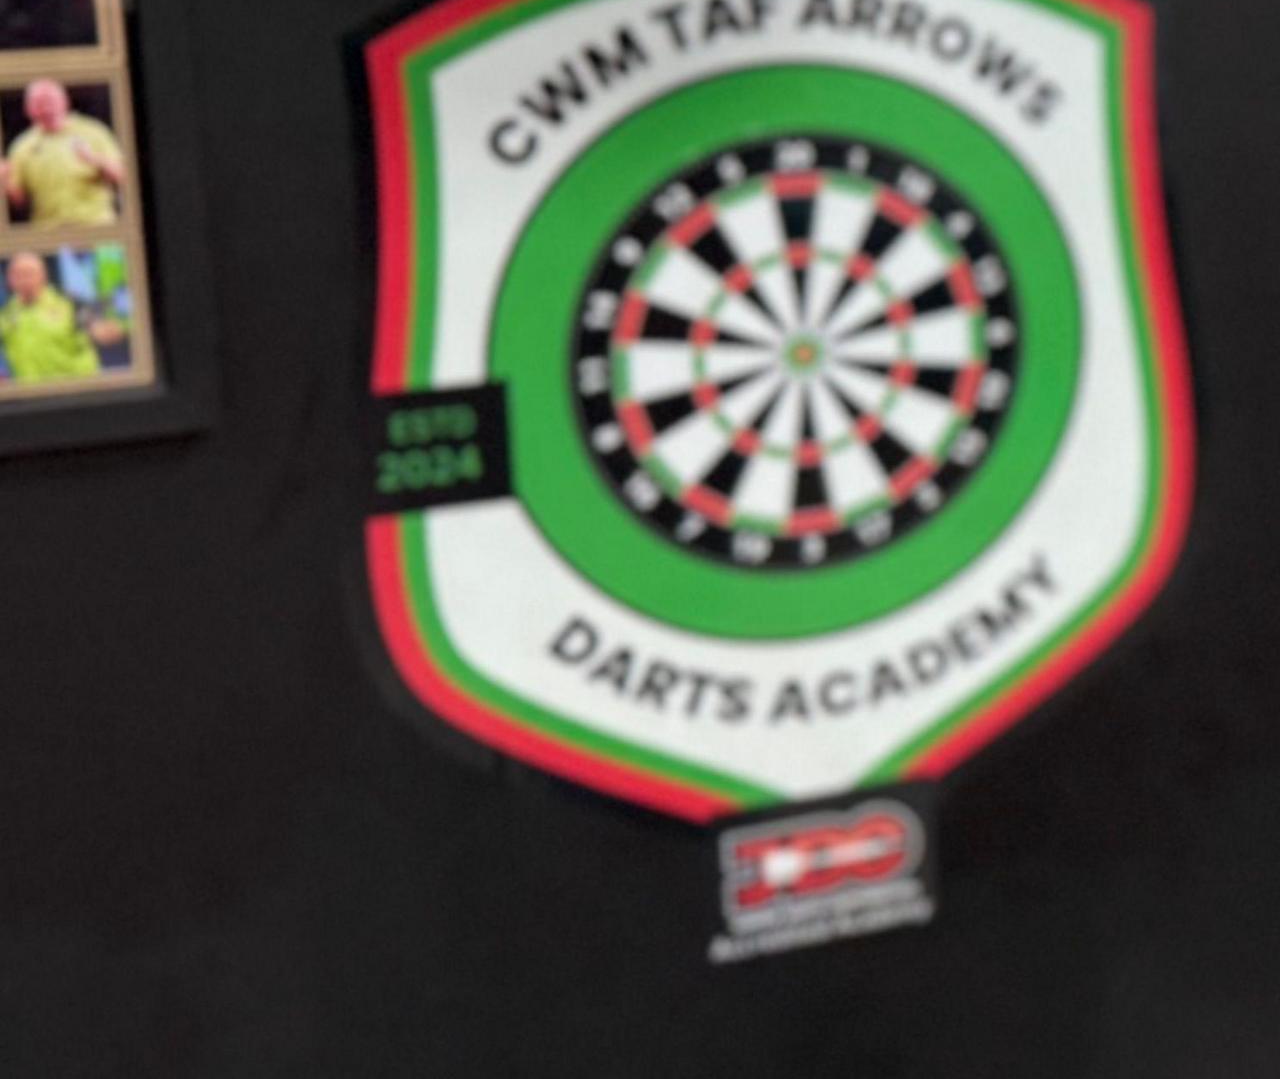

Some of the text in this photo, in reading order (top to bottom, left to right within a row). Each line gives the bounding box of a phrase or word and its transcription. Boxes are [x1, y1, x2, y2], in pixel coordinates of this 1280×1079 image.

[486, 32, 648, 169] CWM
[376, 443, 483, 493] 2024
[549, 552, 1063, 724] DARTS ACADEMY
